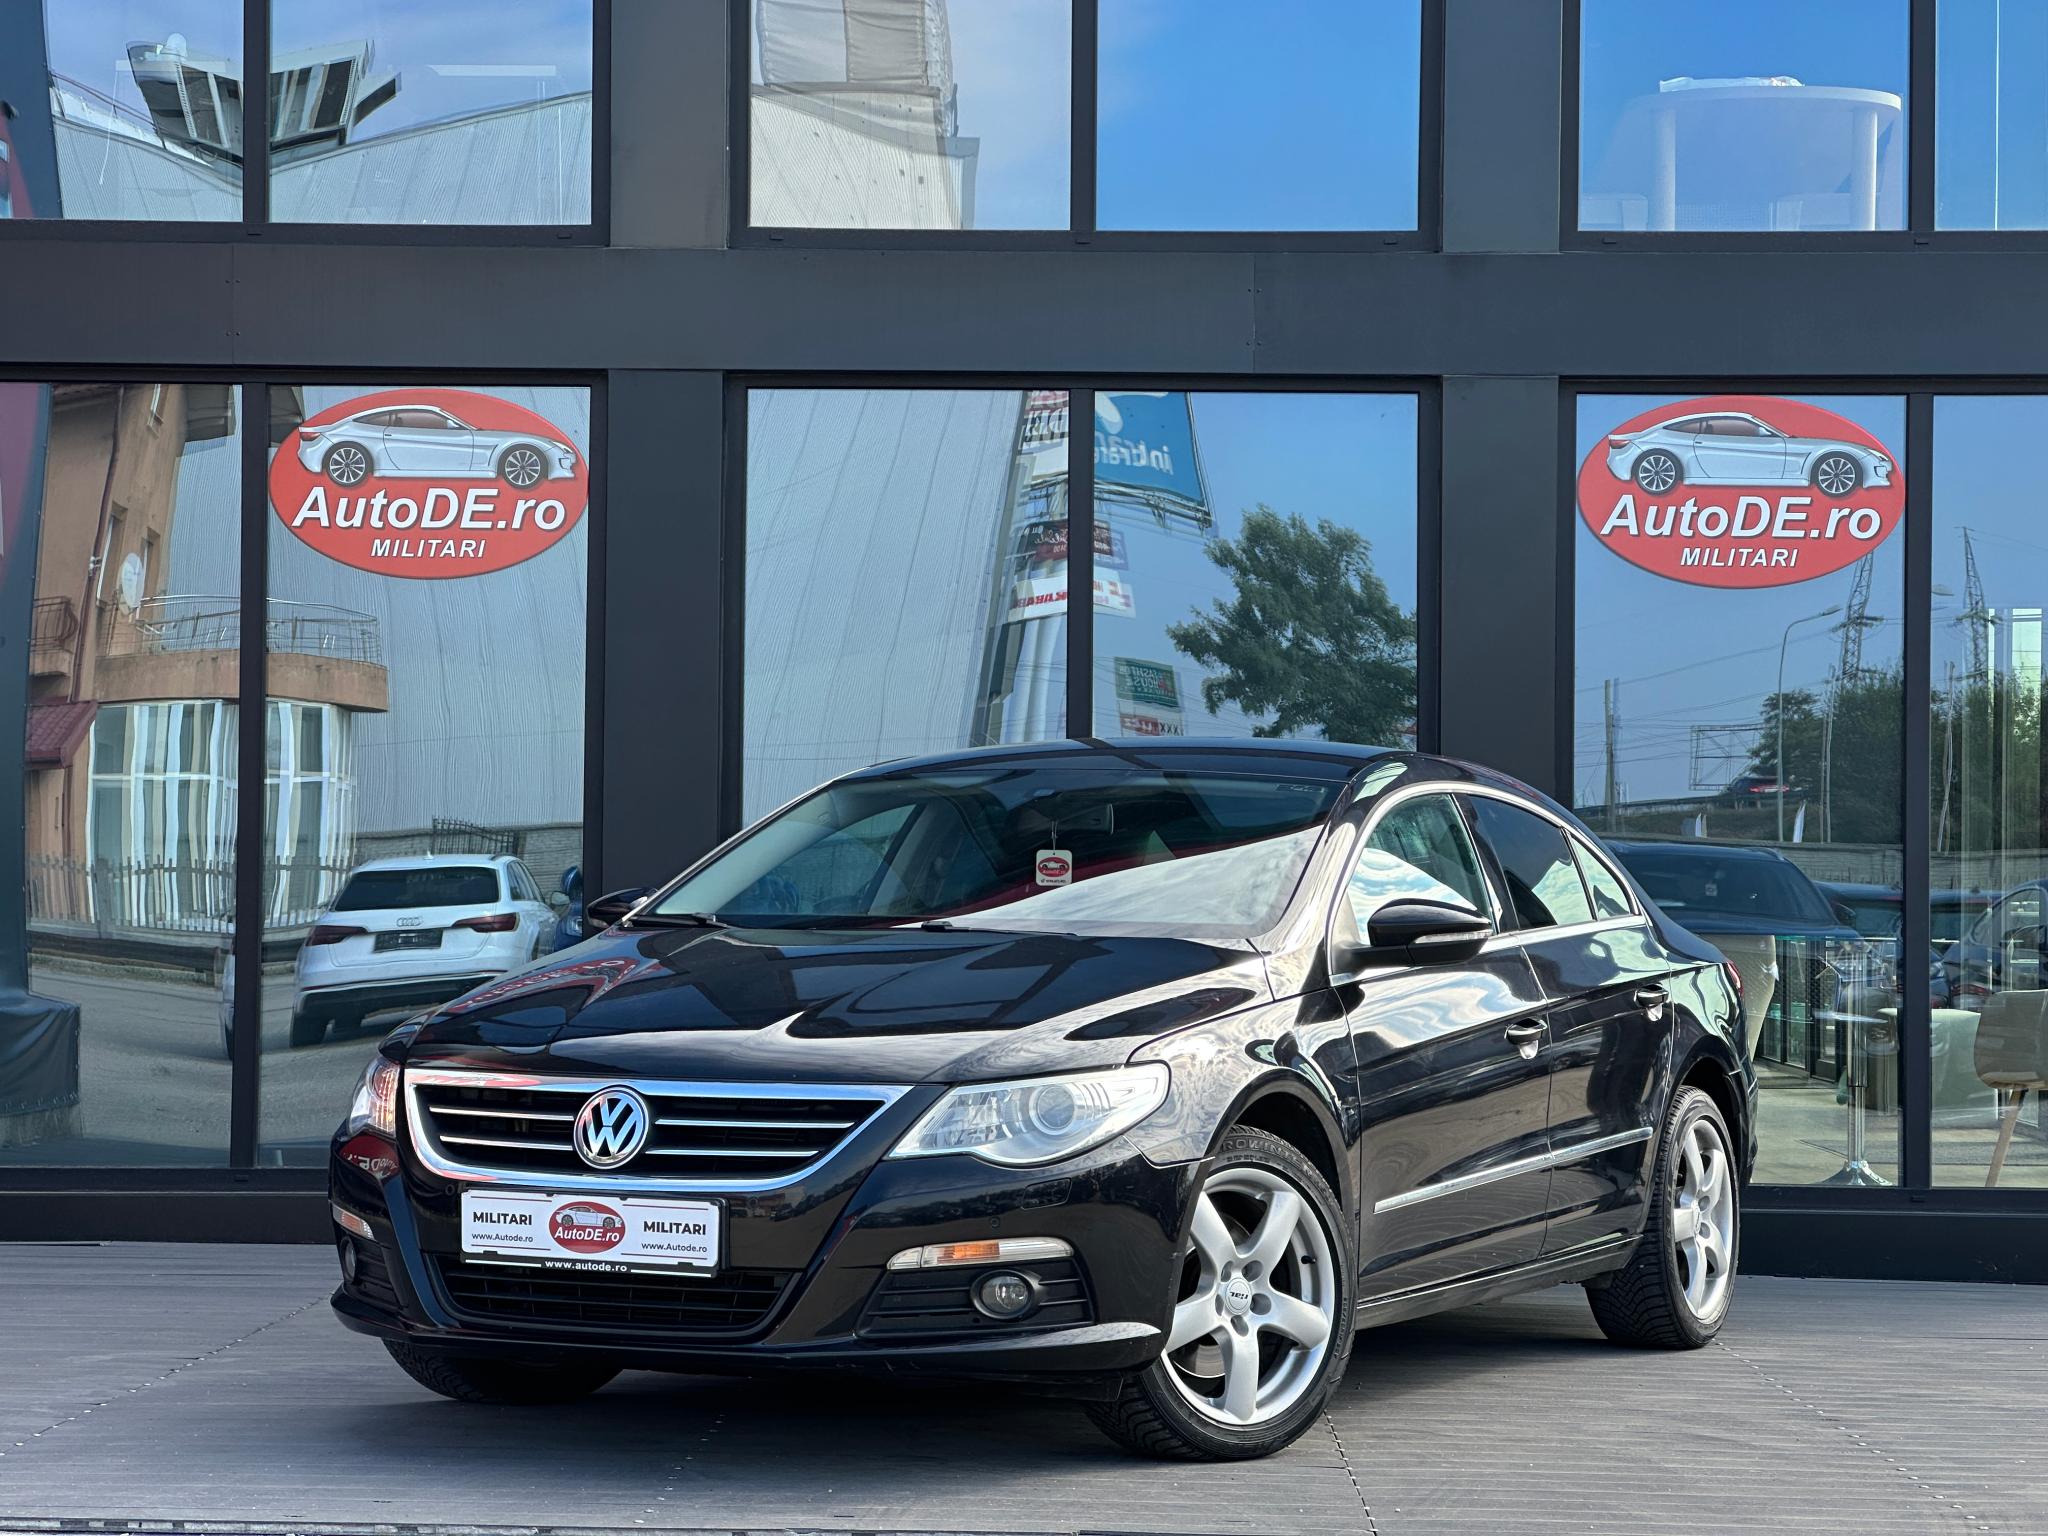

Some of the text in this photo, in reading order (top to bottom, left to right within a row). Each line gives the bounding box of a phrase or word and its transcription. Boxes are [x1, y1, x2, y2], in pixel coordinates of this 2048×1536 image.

[291, 486, 566, 531] AutoDE.ro
[1600, 494, 1882, 539] AutoDE.ro
[370, 538, 486, 558] MILITARI
[1680, 547, 1799, 568] MILITARI
[473, 1211, 532, 1226] MILITARI
[554, 1227, 620, 1243] AutoDE.ro
[643, 1220, 706, 1236] MILITARI
[472, 1232, 533, 1243] www.Autode.ro
[641, 1242, 707, 1253] www.Autode.ro
[545, 1260, 627, 1272] www.autode.ro
